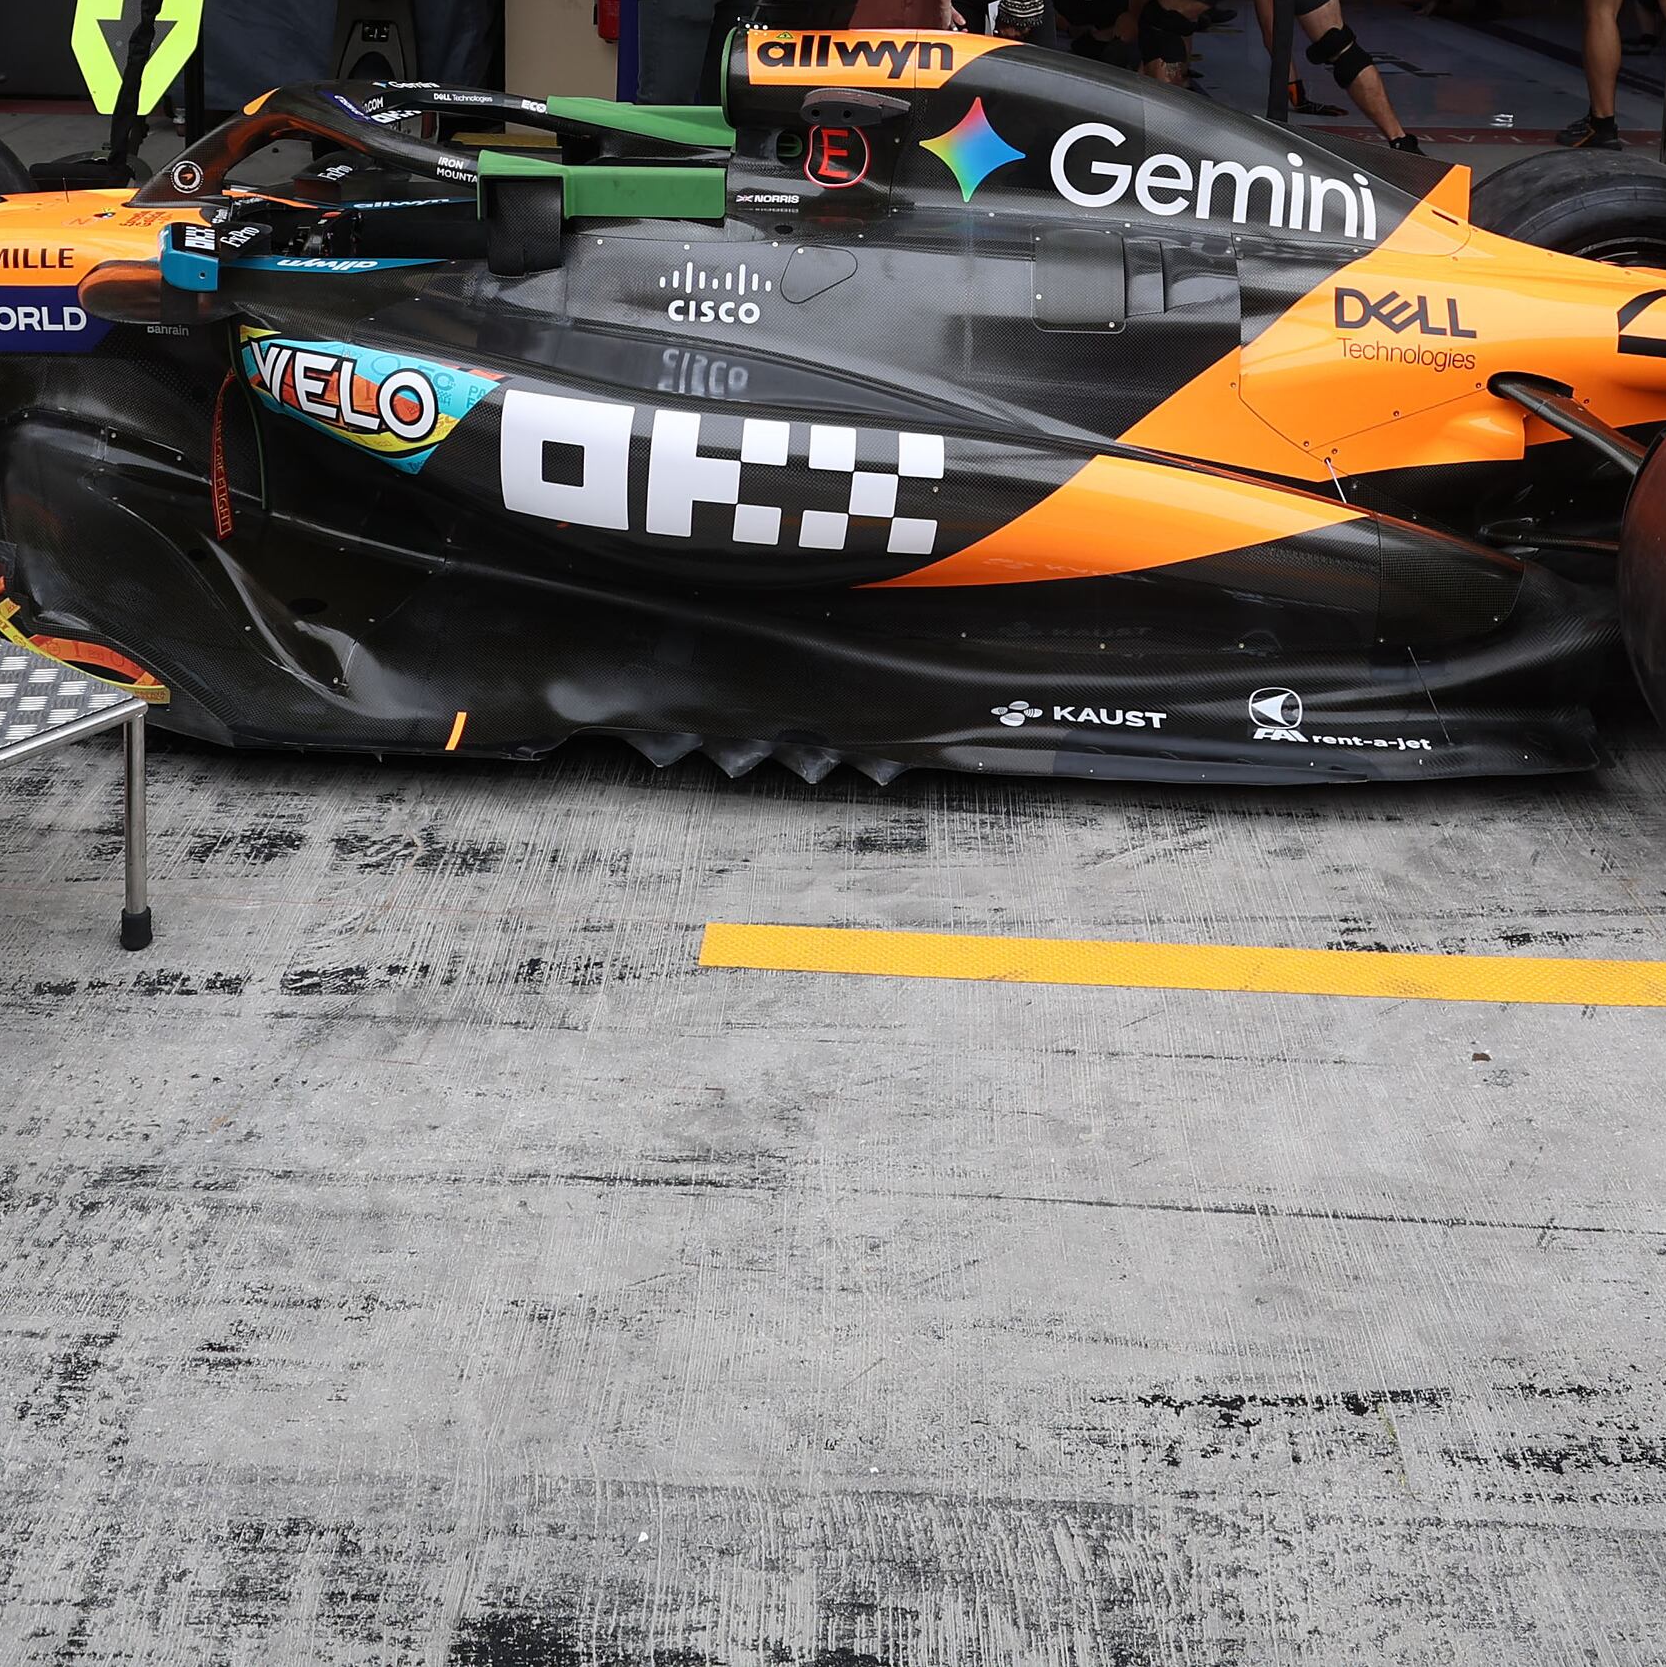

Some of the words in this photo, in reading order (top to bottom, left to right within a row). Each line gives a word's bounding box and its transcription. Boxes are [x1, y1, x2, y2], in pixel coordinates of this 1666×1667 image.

[756, 33, 953, 80] allwyn
[434, 93, 453, 102] DELL
[454, 93, 493, 103] Technologies
[438, 156, 464, 170] IRON
[818, 129, 847, 179] E
[437, 167, 478, 184] MOUNTA
[1051, 123, 1378, 241] Gemini
[354, 198, 450, 210] allwyn
[754, 195, 800, 204] NORRIS
[220, 225, 260, 248] FxPro
[276, 257, 378, 272] allwyn
[668, 300, 761, 324] CISCO
[1334, 288, 1477, 339] DELL
[1339, 337, 1476, 373] Technologies
[251, 340, 435, 440] VELO
[501, 389, 945, 556] OKX
[1053, 706, 1167, 730] KAUST
[1312, 733, 1432, 752] rent-a-jet
